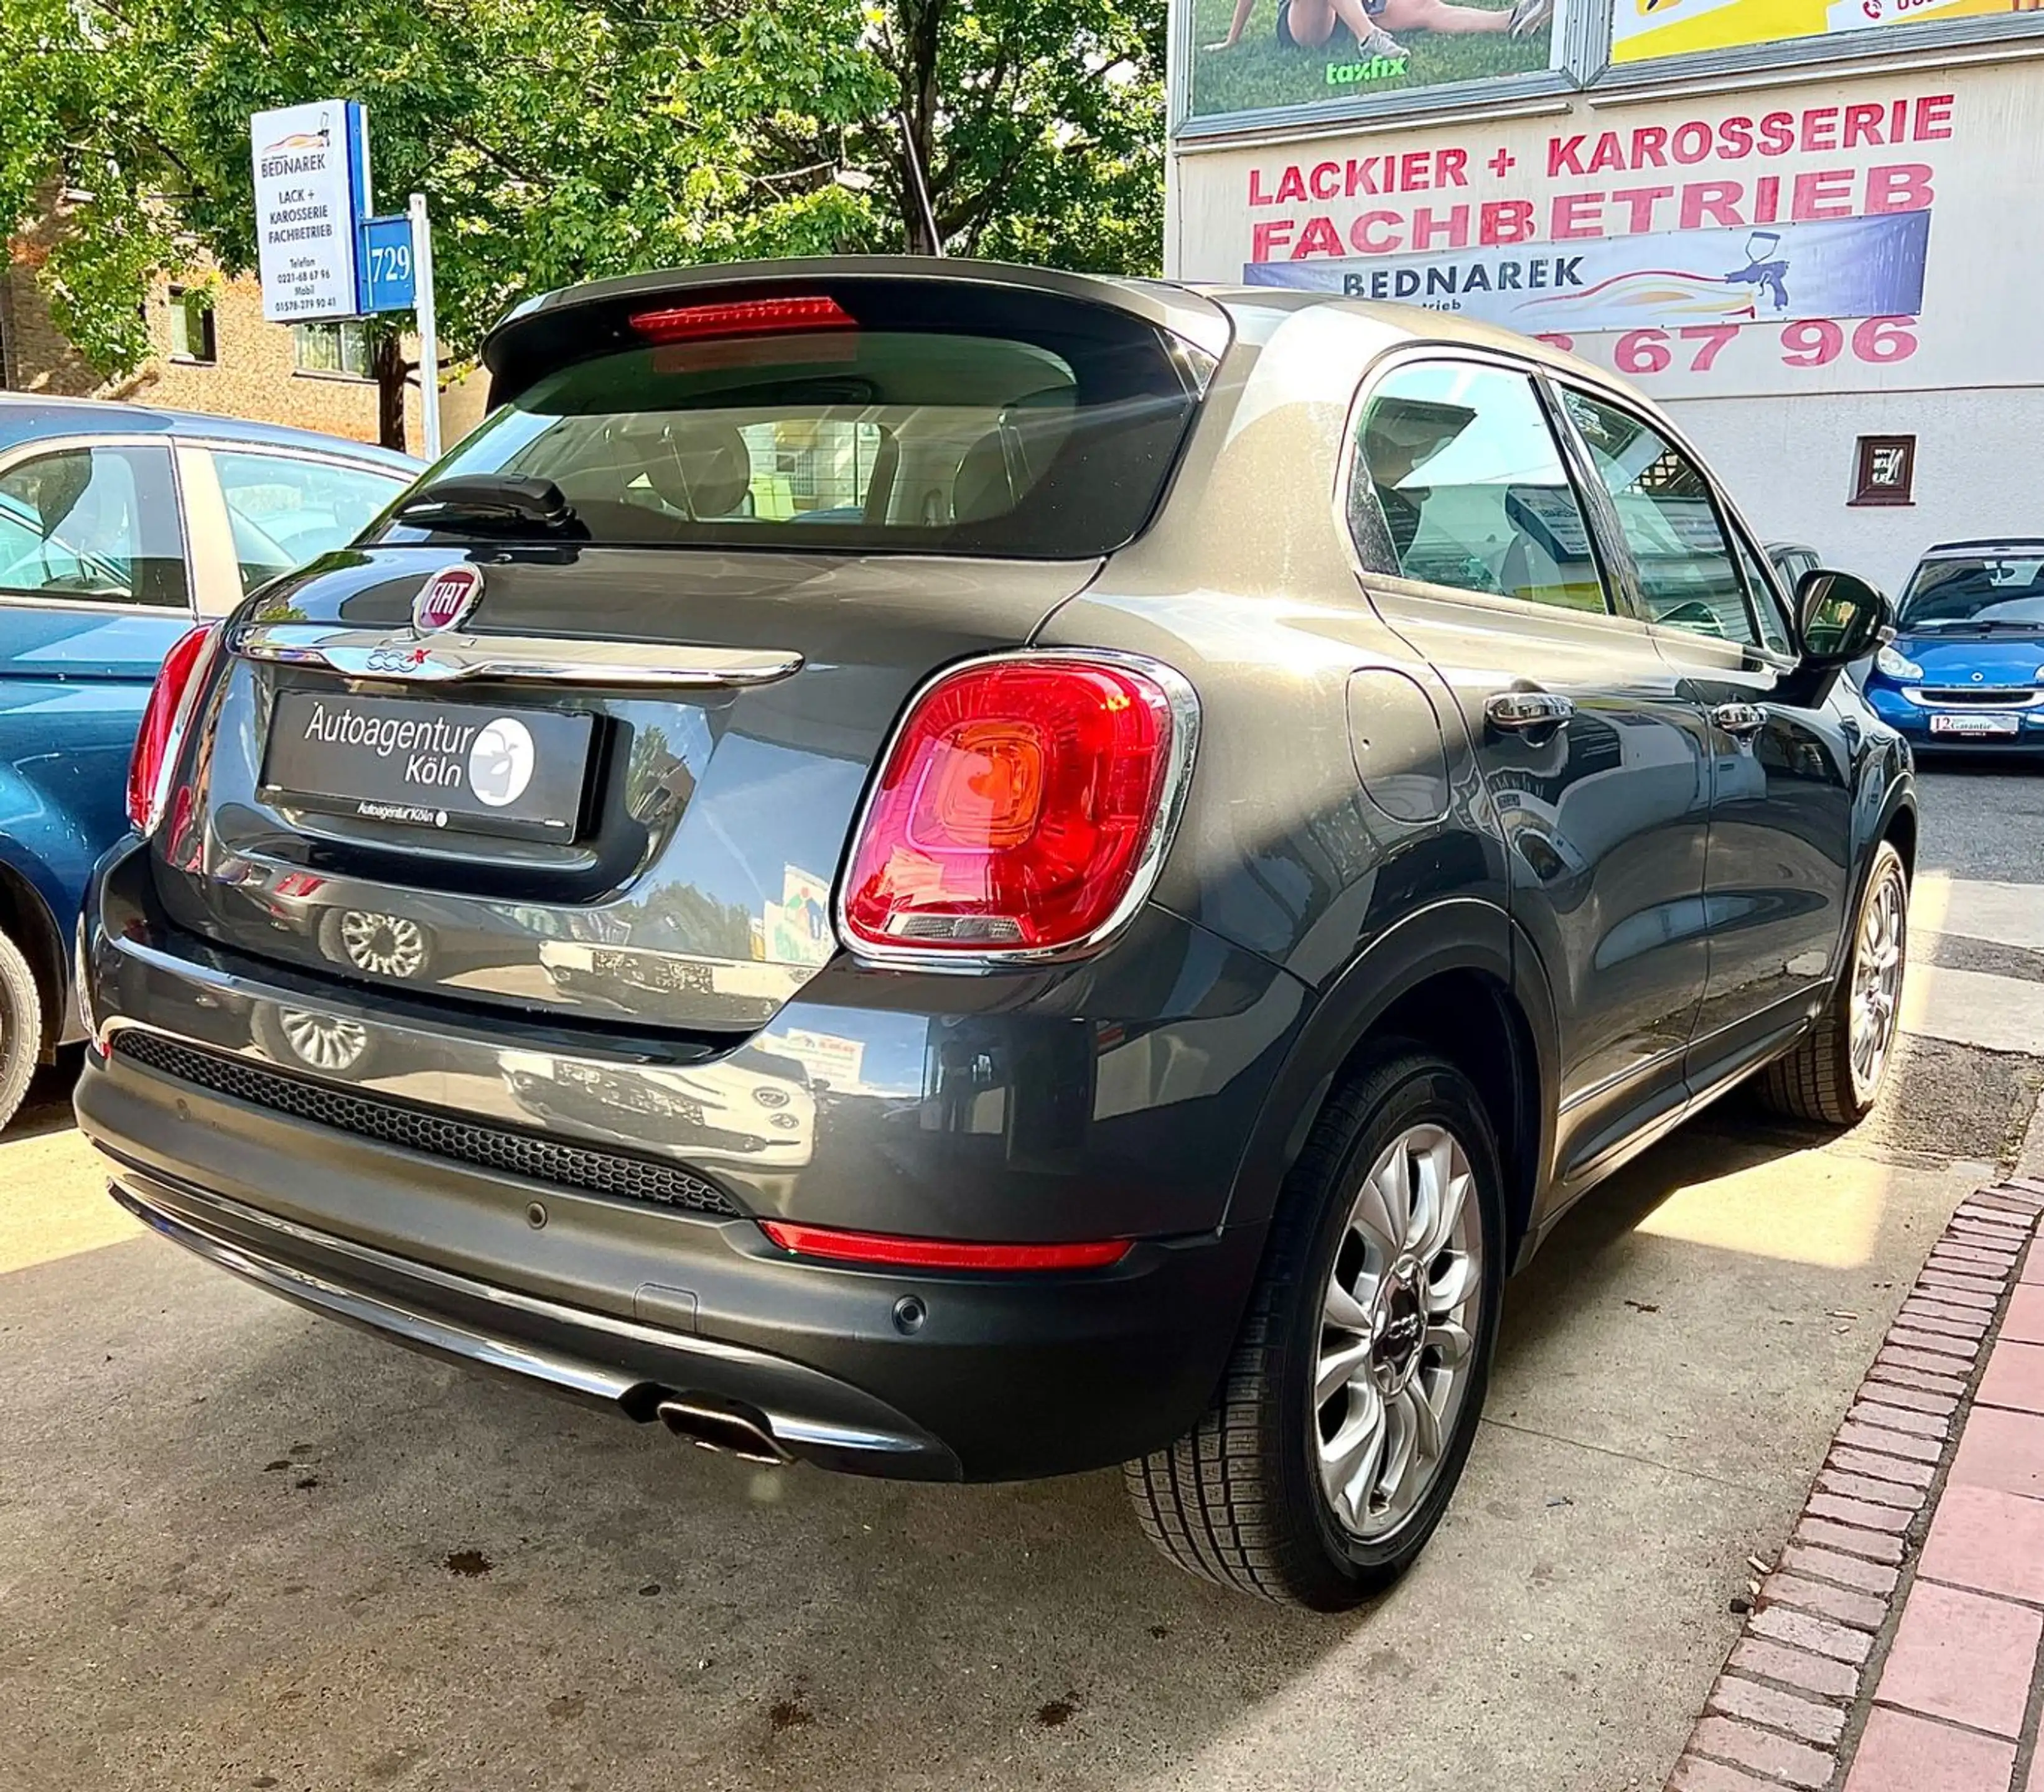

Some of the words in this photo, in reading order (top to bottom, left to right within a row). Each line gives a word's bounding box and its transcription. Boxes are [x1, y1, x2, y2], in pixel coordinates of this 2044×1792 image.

[1326, 55, 1407, 85] taxfix
[261, 153, 325, 179] BEDNAREK
[1248, 148, 1468, 206] LACKIER
[1488, 148, 1516, 178] +
[1547, 94, 1955, 177] KAROSSERIE
[279, 189, 305, 205] LACK
[1252, 163, 1935, 263] FACHBETRIEB
[269, 204, 328, 225] KAROSSERIE
[268, 223, 333, 244] FACHBETRIEB
[289, 256, 315, 268] Telefon
[371, 245, 411, 283] 729
[1343, 256, 1585, 298] BEDNAREK
[1615, 324, 1740, 373] 67
[1781, 314, 1918, 366] 96
[427, 582, 470, 614] FIAT
[305, 705, 476, 757] Autoagentur
[405, 754, 463, 787] Köln
[357, 801, 411, 819] Autoagentur
[410, 808, 434, 823] Köln
